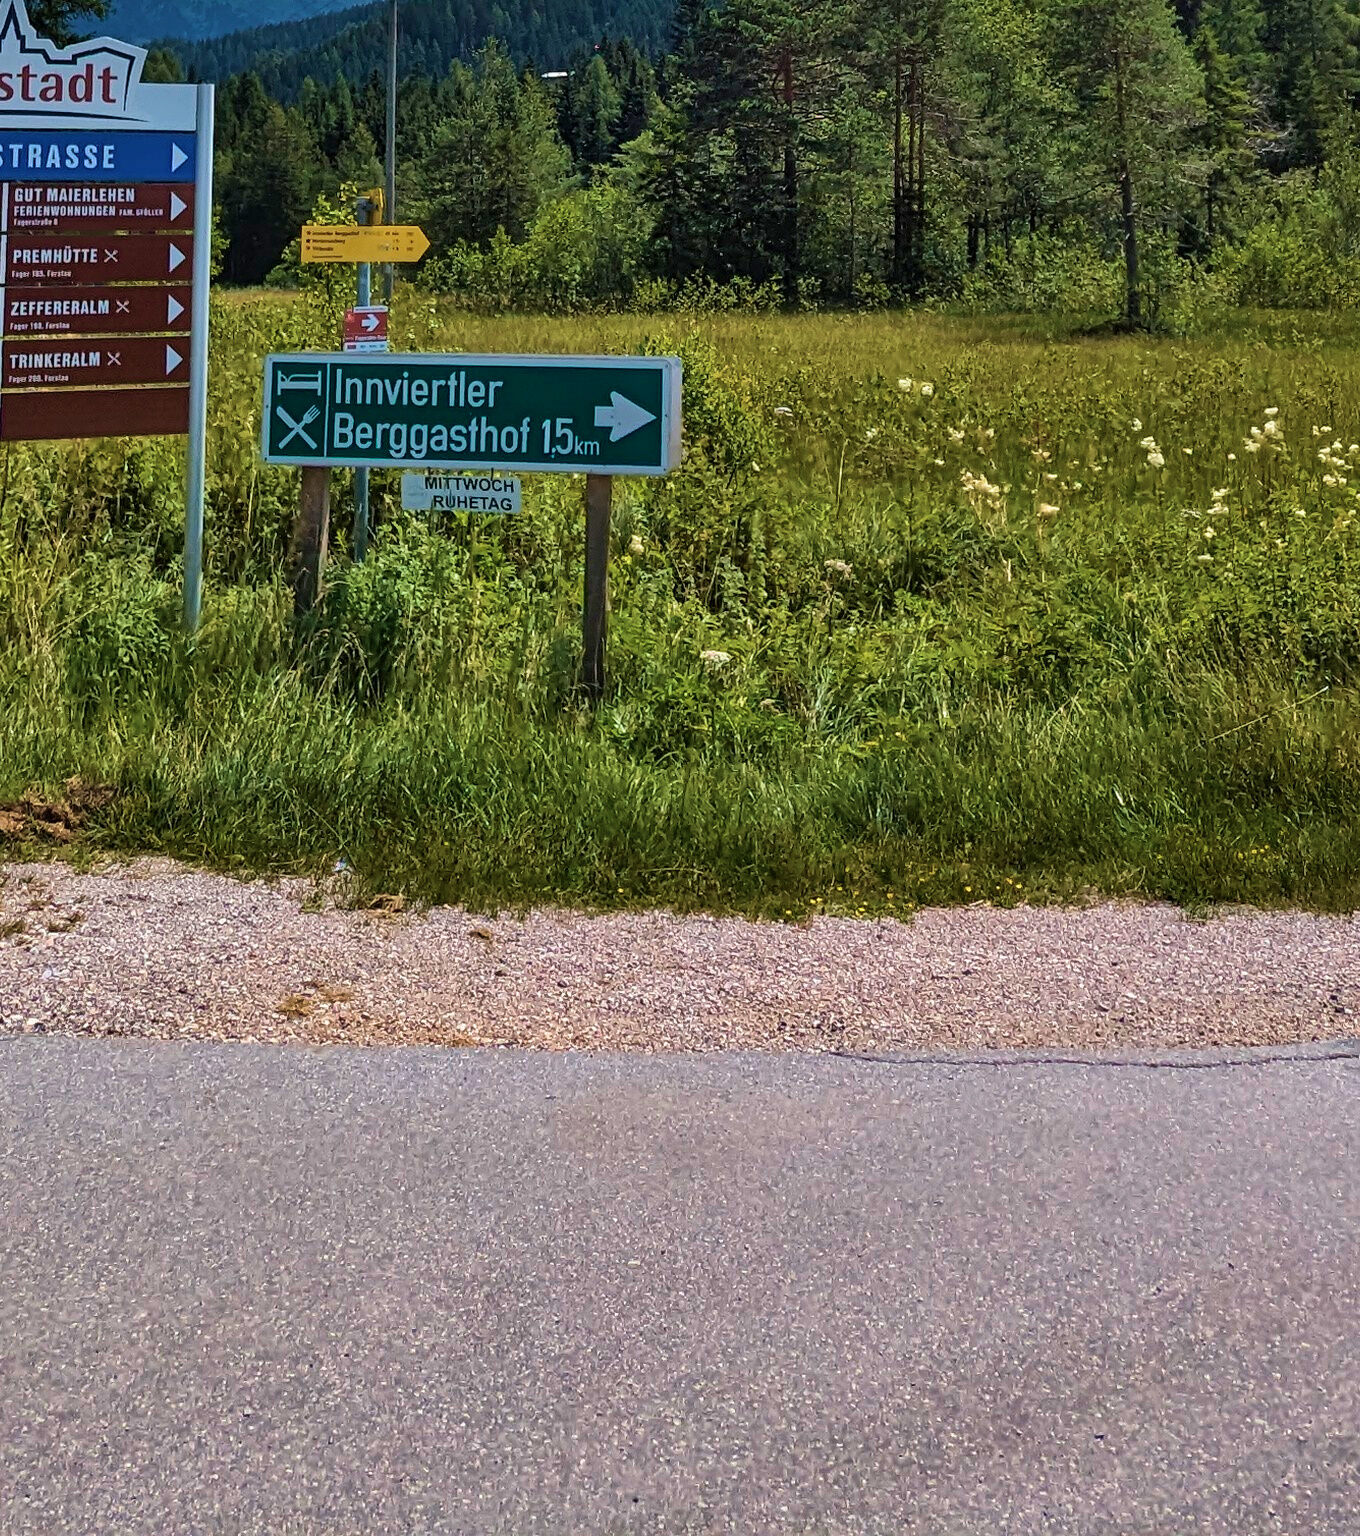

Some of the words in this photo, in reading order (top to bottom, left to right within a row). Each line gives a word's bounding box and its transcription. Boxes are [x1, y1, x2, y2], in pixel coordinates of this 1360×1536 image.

[14, 187, 43, 202] GUT
[46, 188, 135, 203] MAIERLEHEN
[13, 205, 116, 217] FERIENWOHNUNGEN
[13, 245, 98, 264] PREMHÜTTE
[10, 300, 110, 316] ZEFFERERALM
[9, 351, 101, 369] TRINKERALM
[335, 368, 504, 408] Innviertler
[333, 412, 531, 459] Berggasthof
[424, 476, 515, 493] MITTWOCH
[432, 496, 513, 511] RUHETAG
